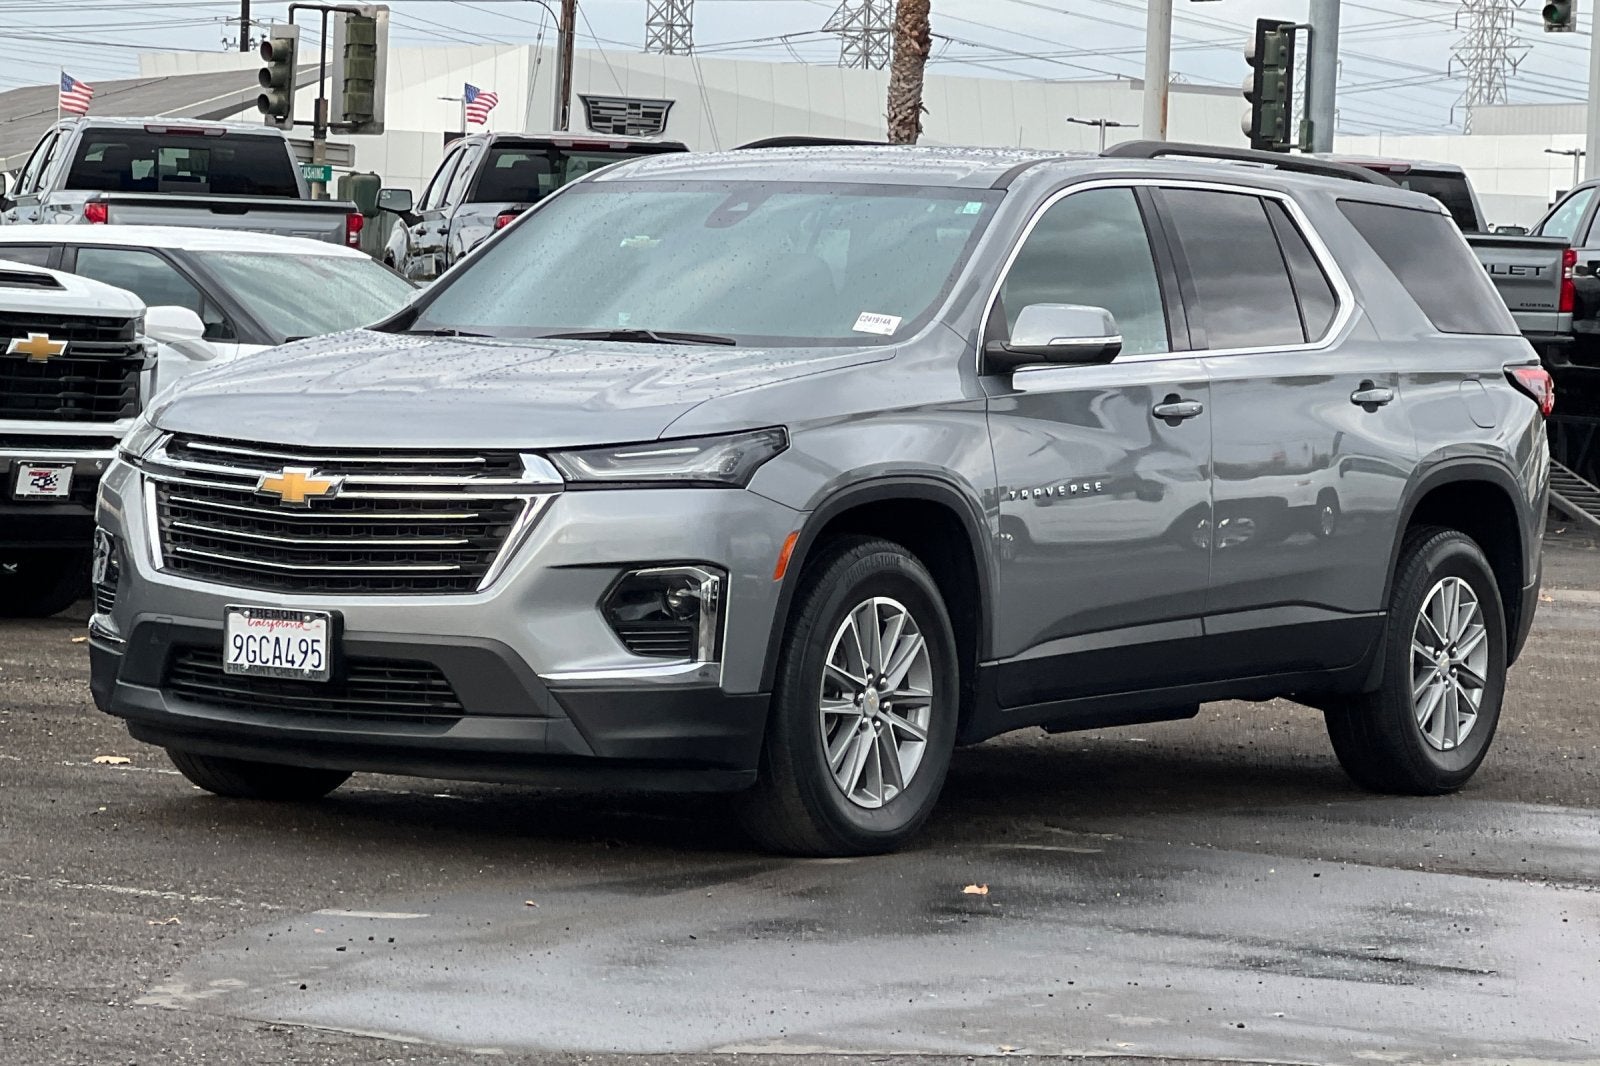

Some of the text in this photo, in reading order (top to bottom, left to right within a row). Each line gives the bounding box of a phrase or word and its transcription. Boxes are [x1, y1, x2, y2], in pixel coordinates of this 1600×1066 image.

[1009, 482, 1102, 500] TRAVERSE
[249, 608, 304, 621] FREMONT
[233, 633, 323, 669] 9GCA495
